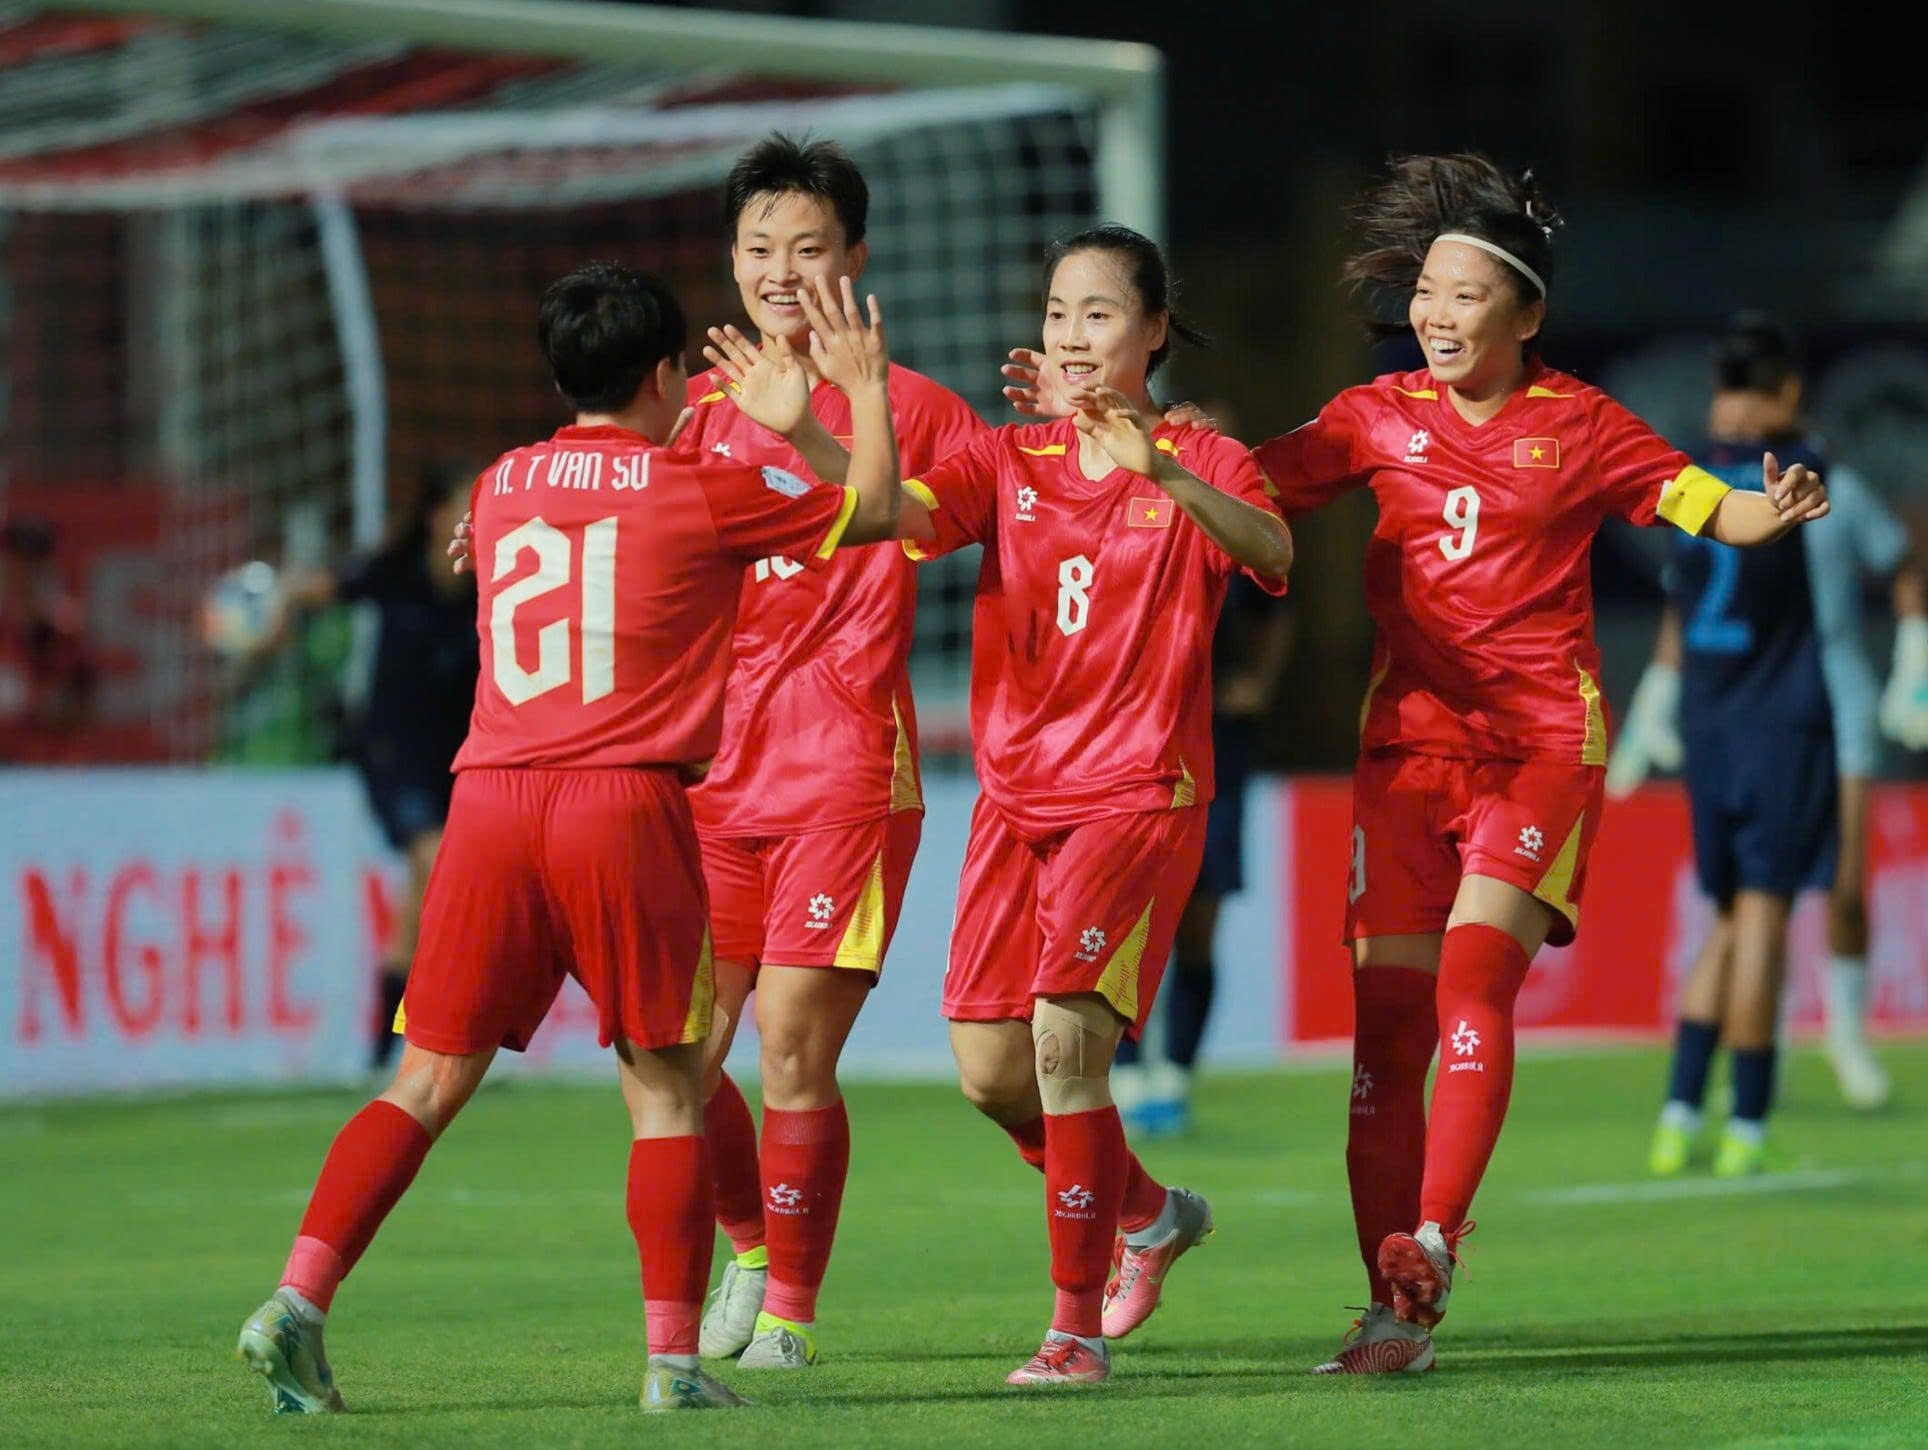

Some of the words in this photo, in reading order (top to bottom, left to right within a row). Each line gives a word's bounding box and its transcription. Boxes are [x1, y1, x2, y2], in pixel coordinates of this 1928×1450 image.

[525, 454, 546, 491] T
[547, 451, 603, 491] VAN
[611, 452, 650, 491] SU
[1438, 484, 1481, 561] 9
[489, 515, 619, 707] 21
[1056, 554, 1094, 637] 8
